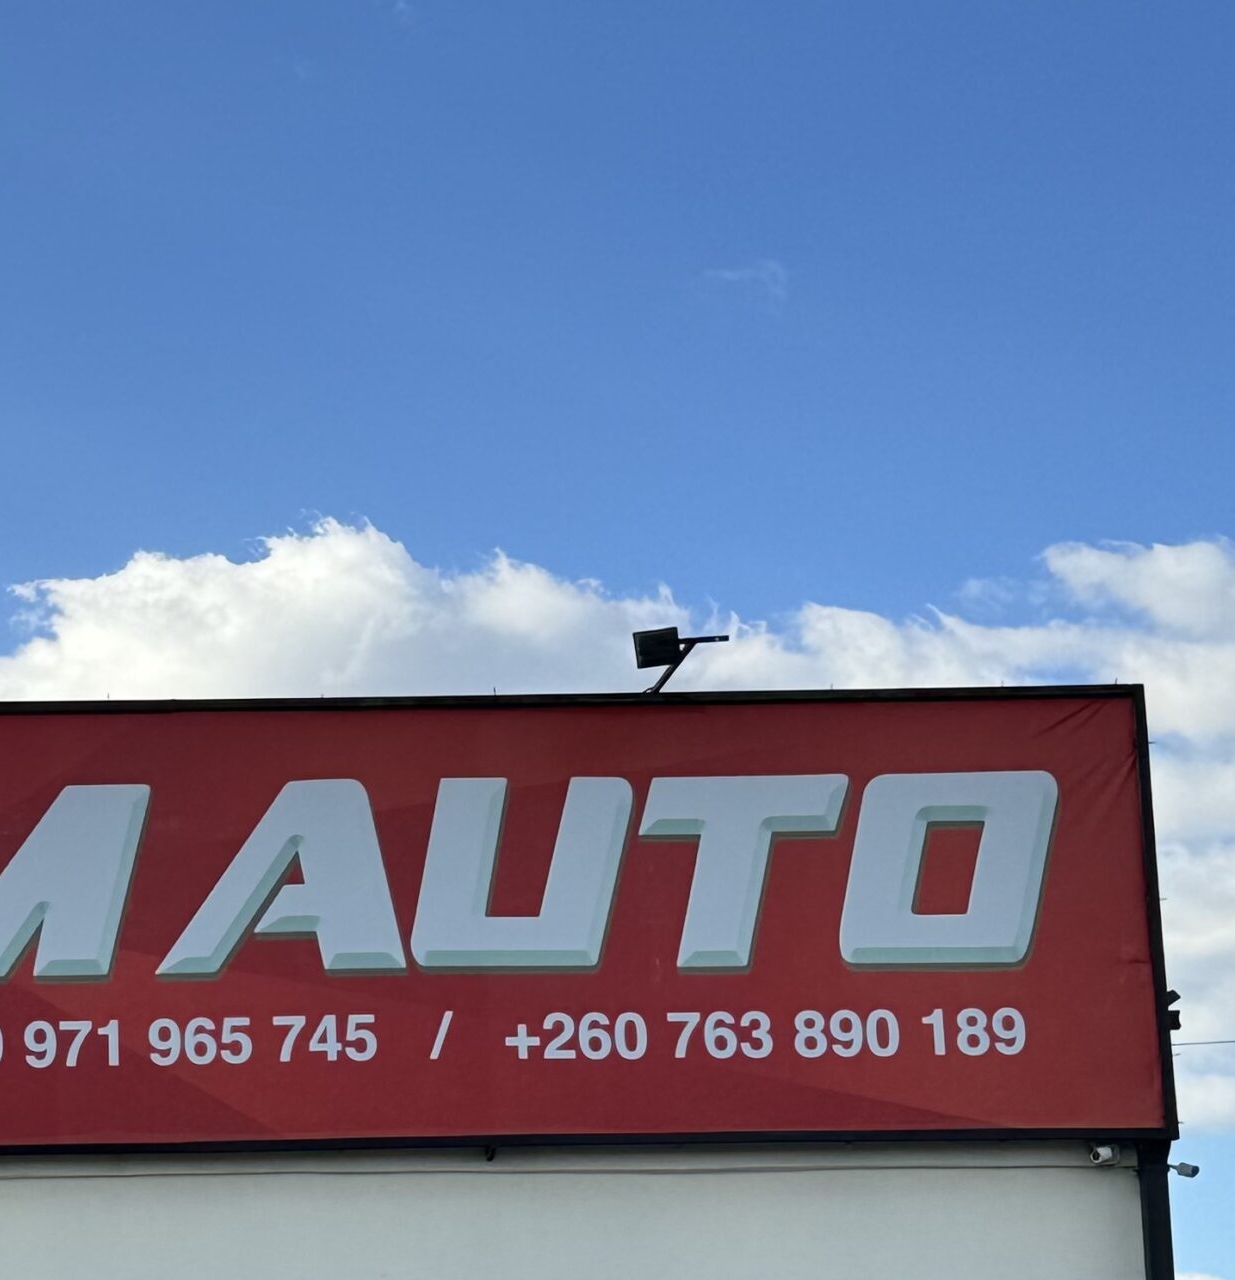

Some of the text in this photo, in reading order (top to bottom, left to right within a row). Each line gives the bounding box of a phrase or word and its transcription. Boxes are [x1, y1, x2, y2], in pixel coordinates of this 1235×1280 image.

[155, 770, 1059, 978] AUTO
[24, 1019, 119, 1069] 971
[148, 1016, 254, 1066] 965
[272, 1014, 378, 1062] 745
[505, 1012, 648, 1060] +260
[666, 1010, 774, 1059] 763
[794, 1009, 900, 1058] 890
[921, 1007, 1026, 1056] 189
